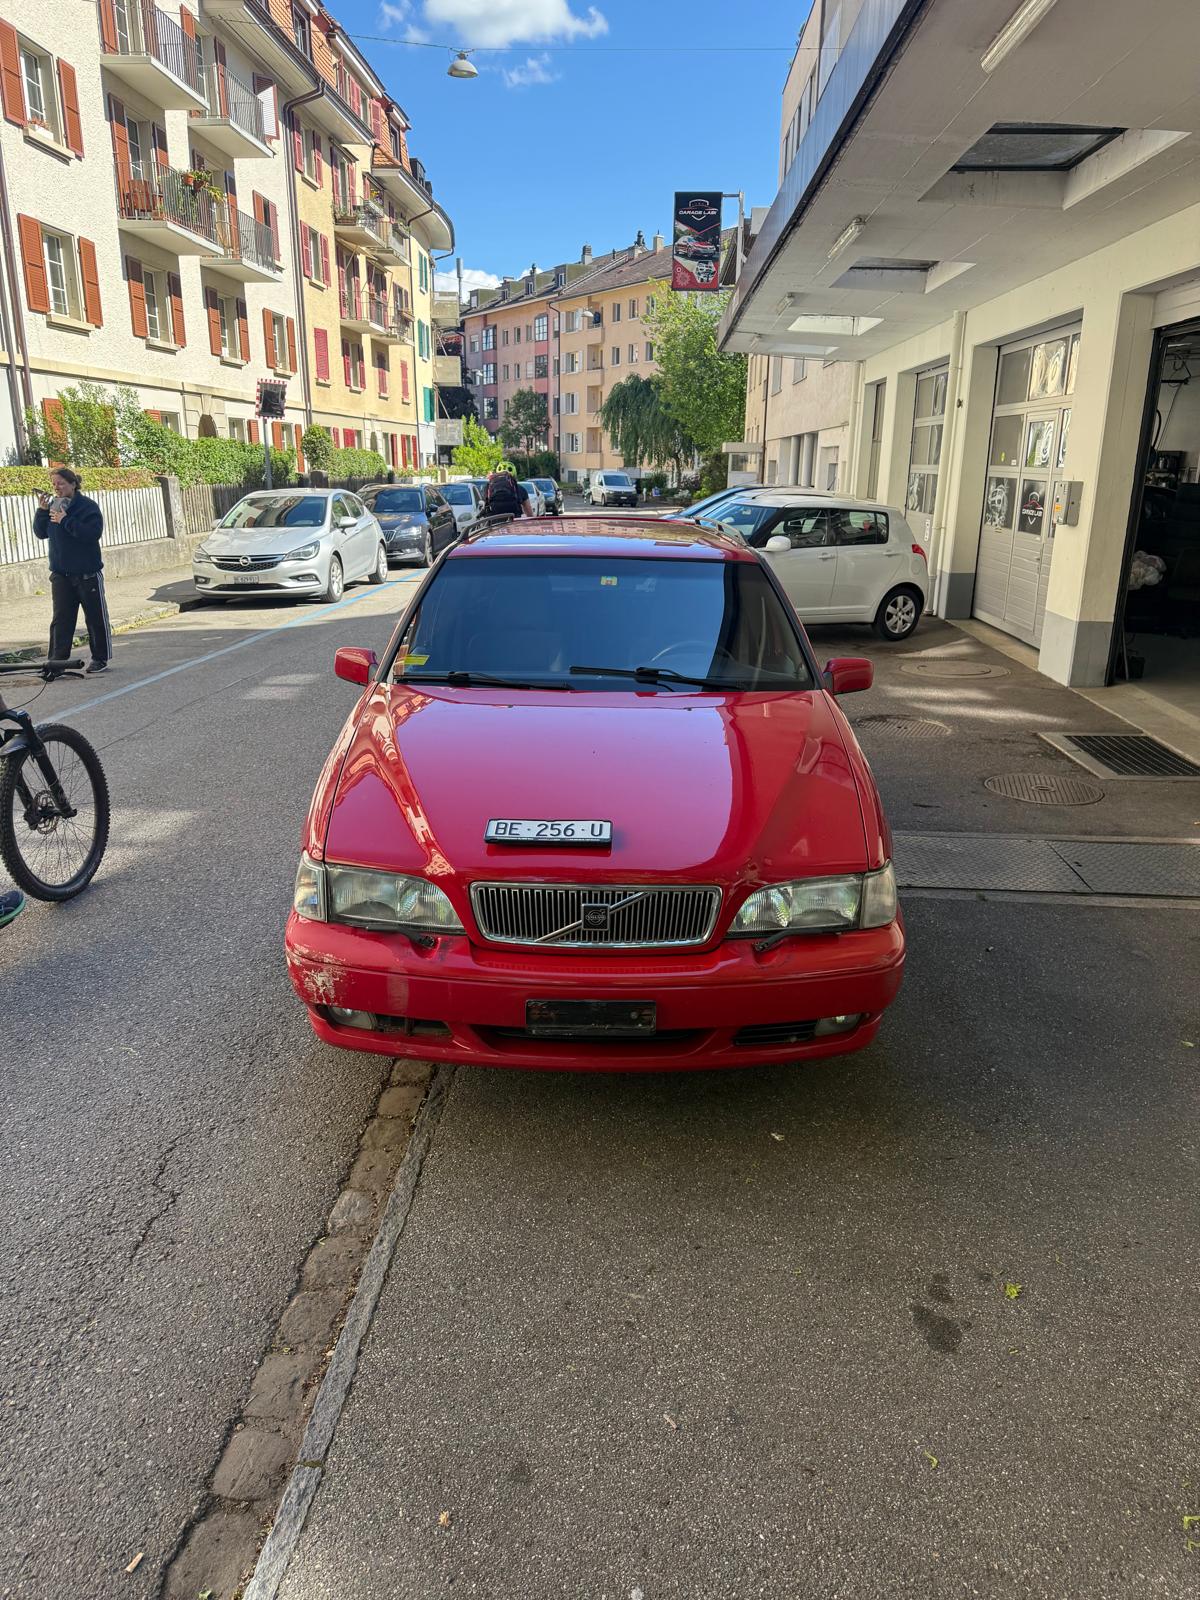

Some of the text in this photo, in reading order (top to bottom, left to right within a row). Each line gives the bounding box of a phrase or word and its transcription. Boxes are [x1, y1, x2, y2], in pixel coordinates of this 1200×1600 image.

[494, 821, 603, 837] BE 256 U
